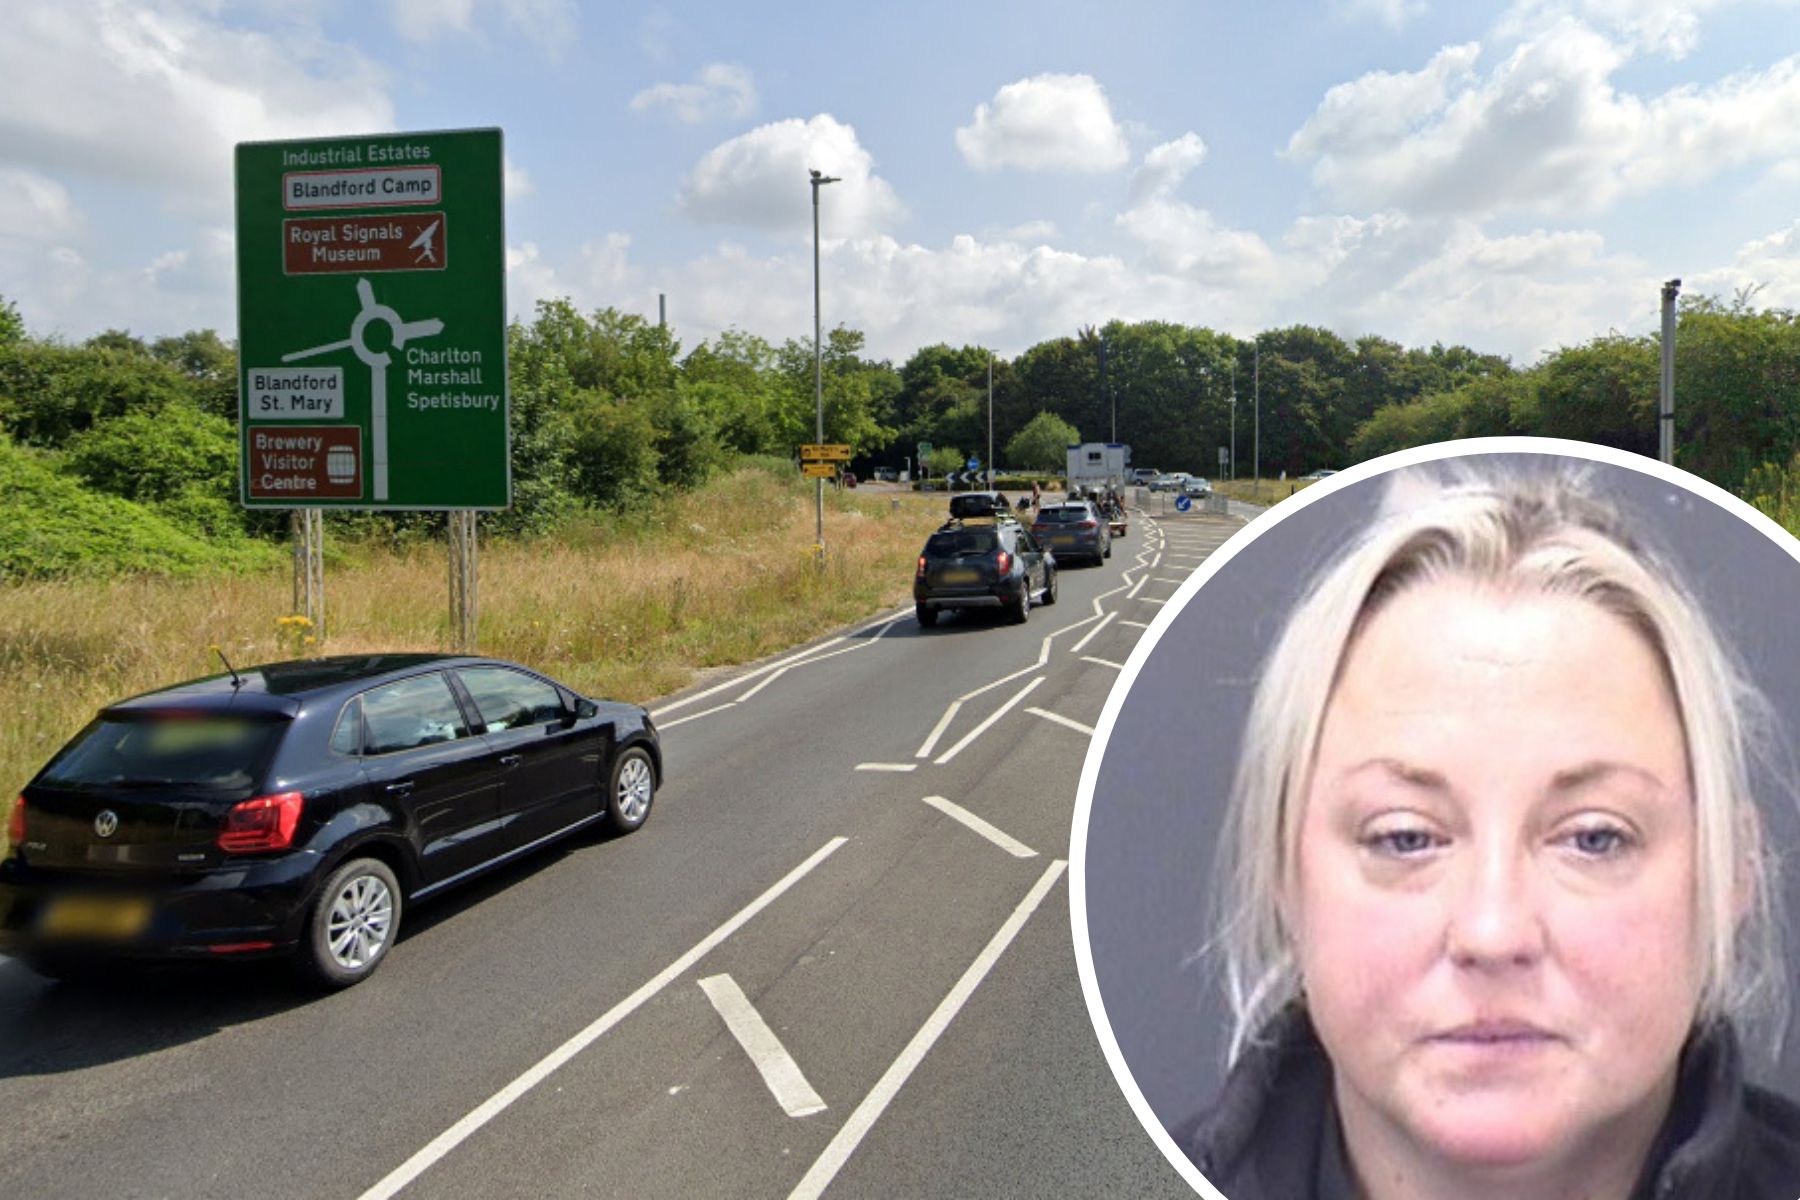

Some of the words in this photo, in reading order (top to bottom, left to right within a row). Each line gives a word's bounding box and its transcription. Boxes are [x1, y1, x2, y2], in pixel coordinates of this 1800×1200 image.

[283, 146, 362, 166] Industrial
[368, 143, 430, 162] Estates
[293, 179, 376, 198] Blandford
[382, 177, 432, 195] Camp
[291, 226, 336, 245] Royal
[342, 223, 403, 243] Signals
[312, 247, 381, 263] Museum
[406, 347, 482, 364] Charlton
[255, 375, 337, 390] Blandford
[408, 366, 482, 385] Marshall
[261, 396, 284, 411] St.
[291, 394, 333, 413] Mary
[407, 392, 500, 412] Spetisbury
[255, 433, 323, 453] Brewery
[261, 454, 315, 470] Visitor
[261, 474, 317, 490] Centre
